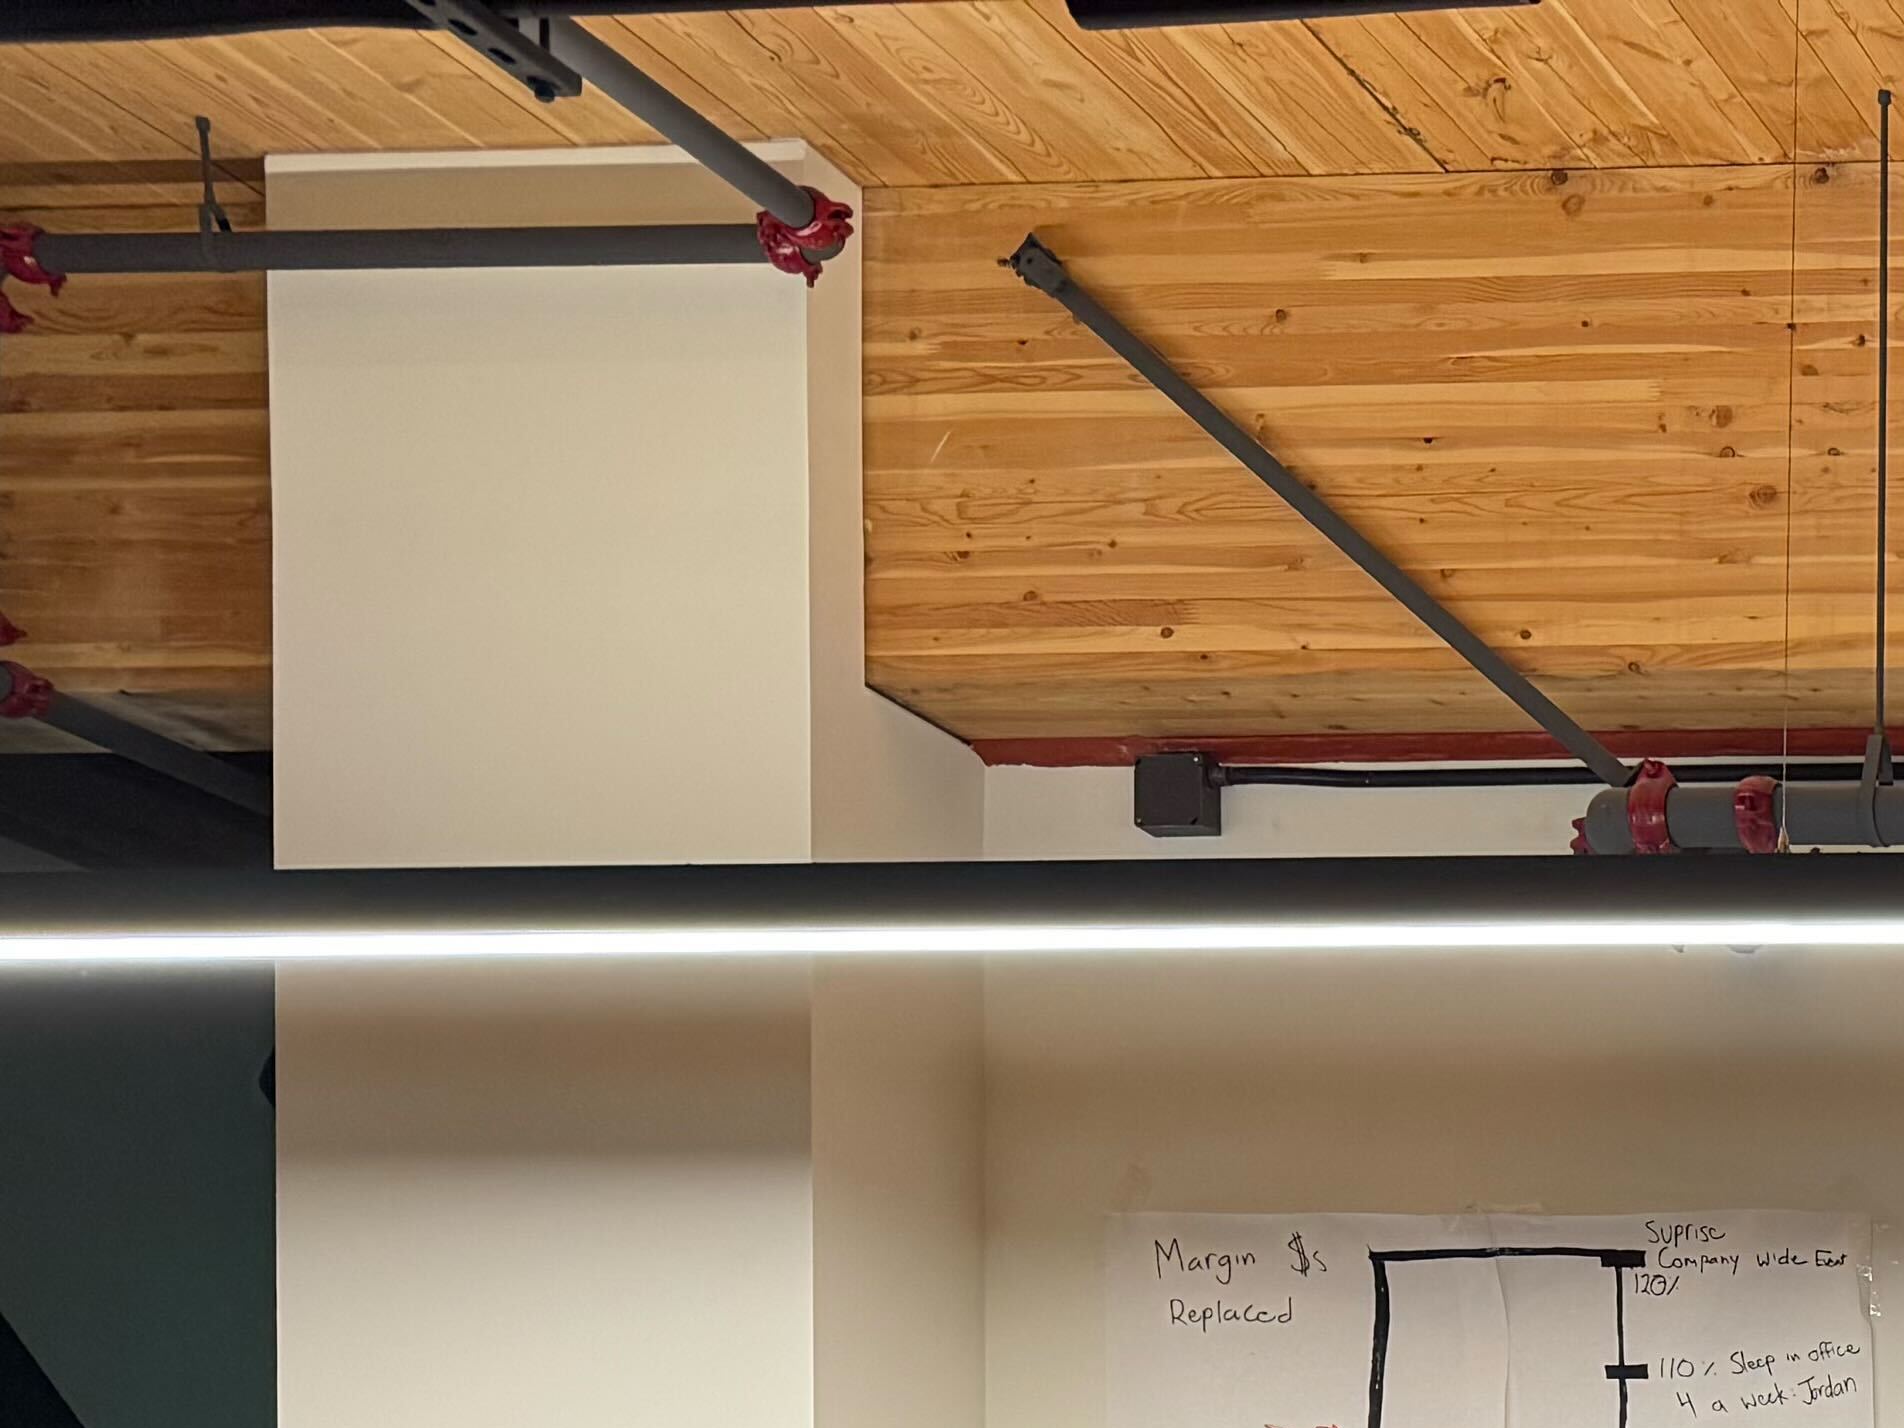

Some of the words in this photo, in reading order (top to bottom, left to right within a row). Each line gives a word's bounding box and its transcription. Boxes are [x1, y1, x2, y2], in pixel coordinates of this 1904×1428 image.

[1154, 1237, 1256, 1285] Margin
[1657, 1248, 1740, 1275] Company
[1168, 1297, 1293, 1333] Replaced
[1730, 1349, 1775, 1375] Sleep
[1711, 1399, 1729, 1413] a
